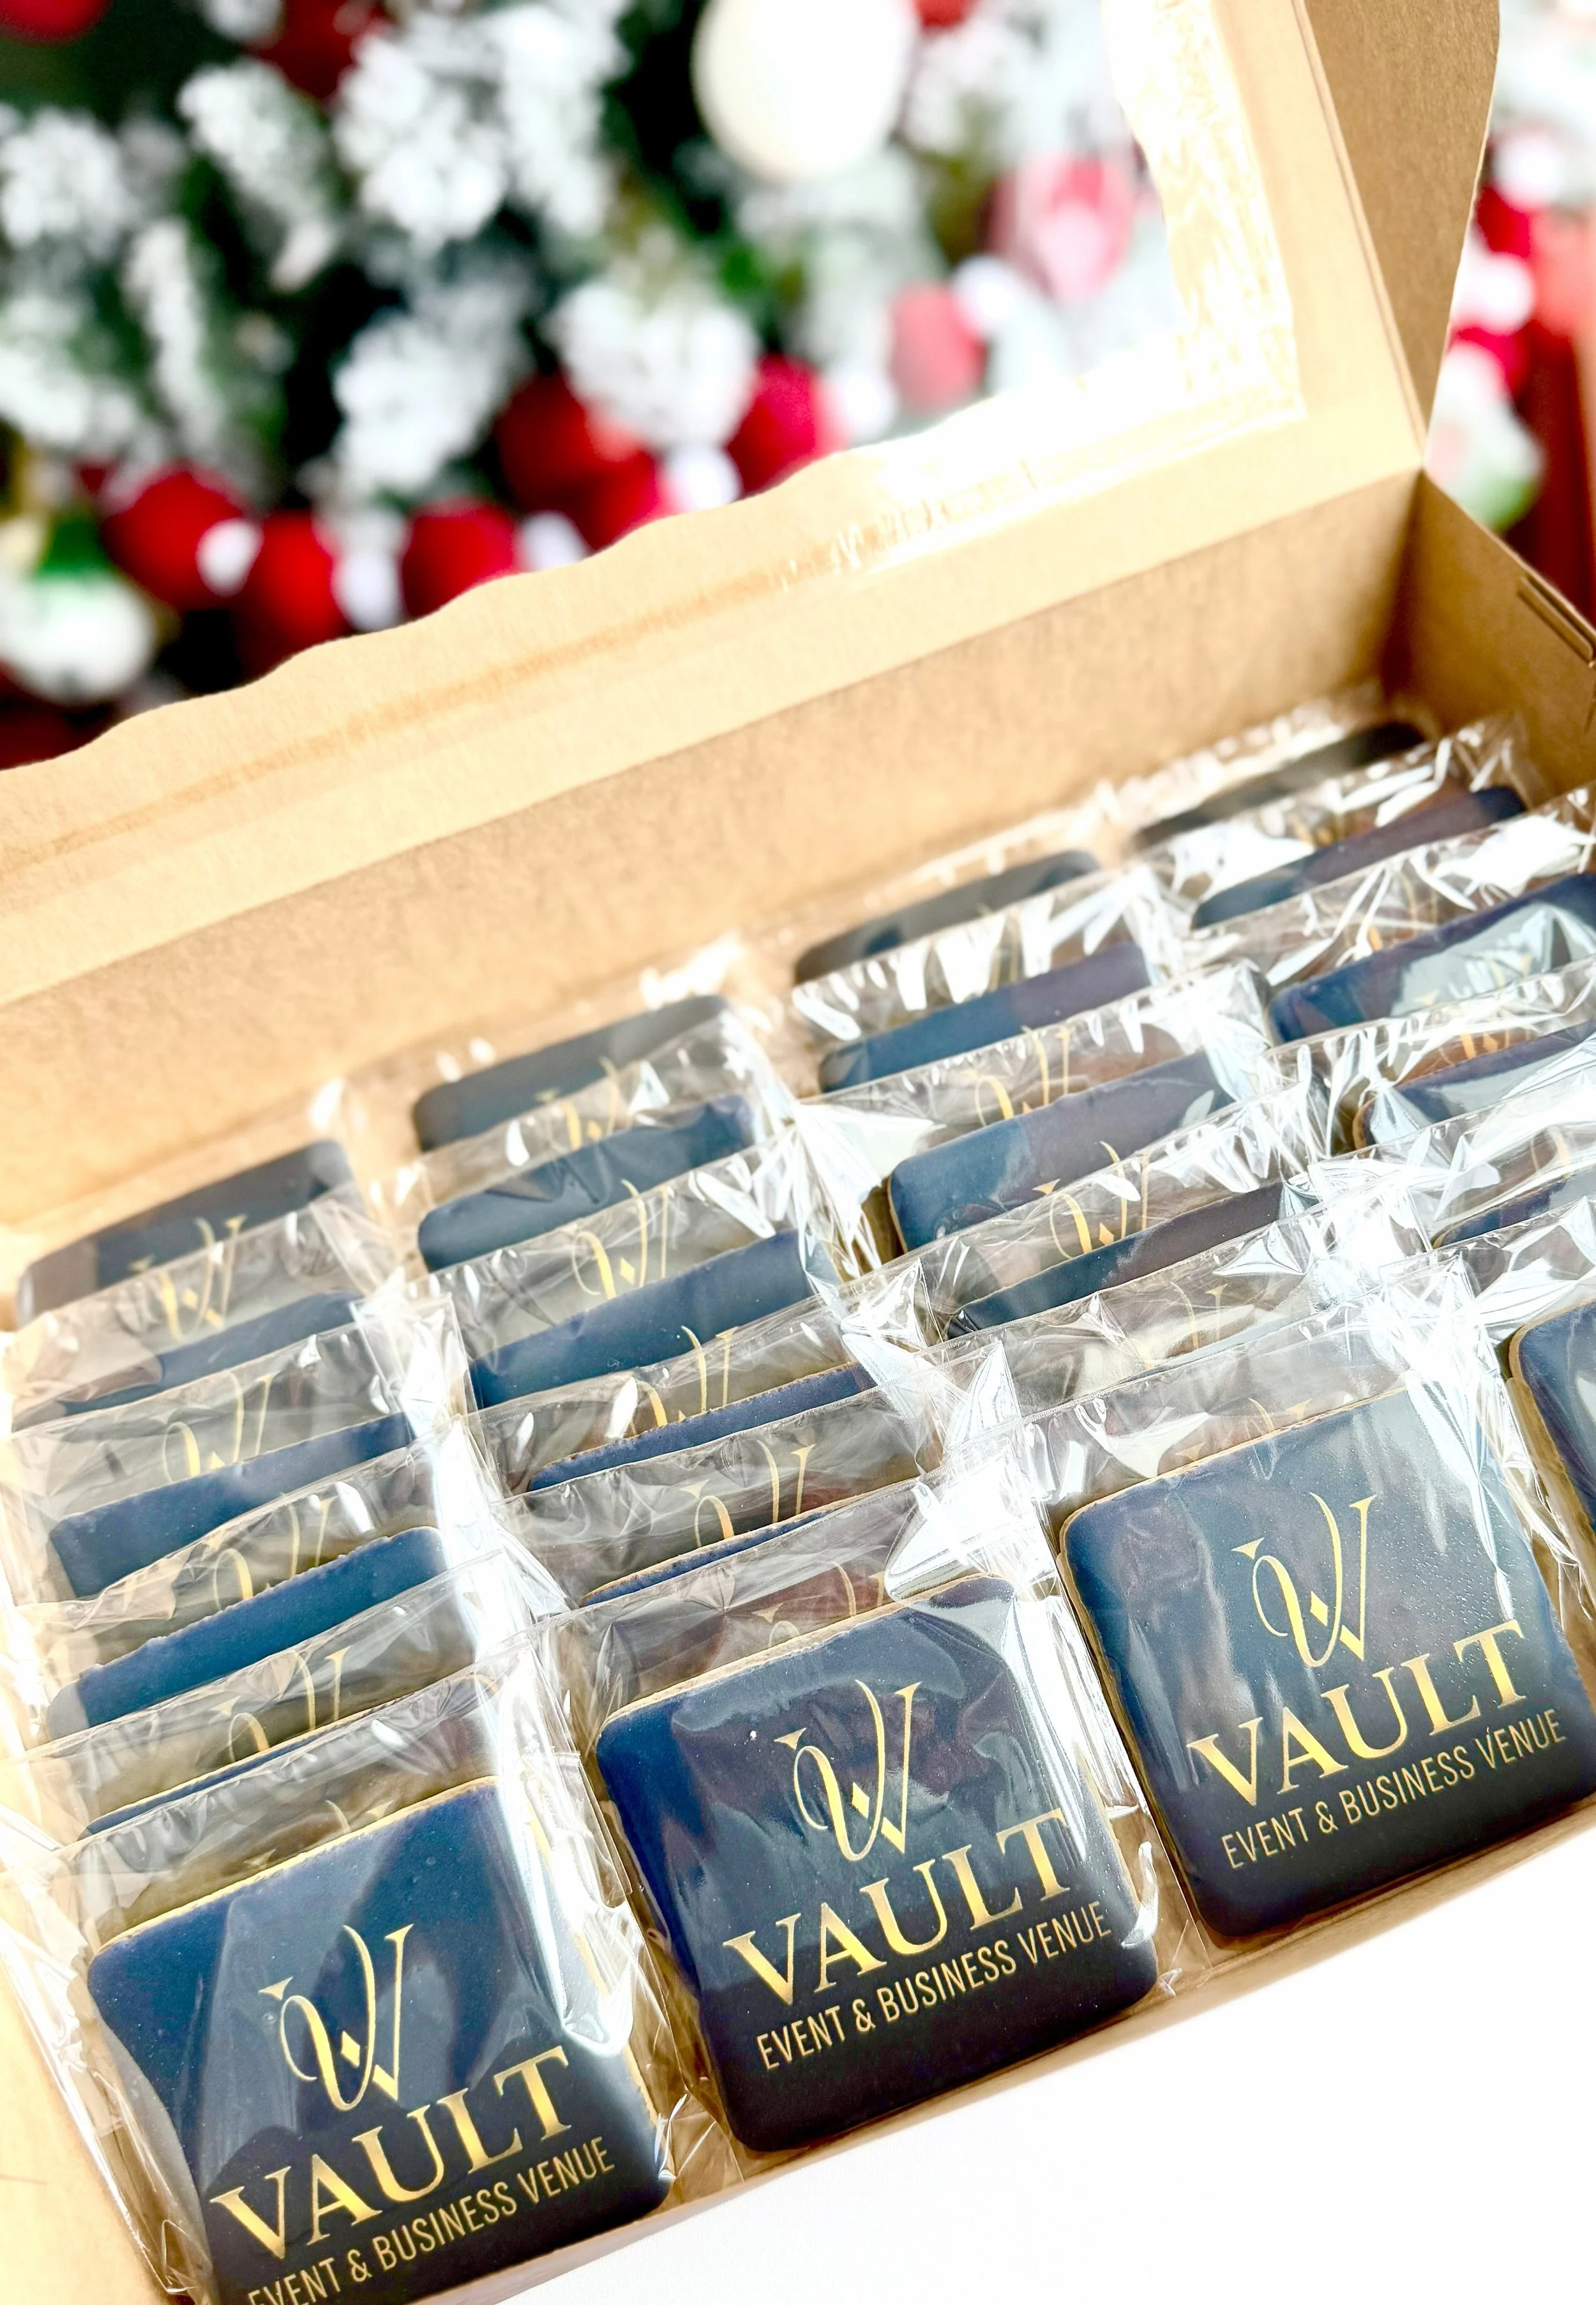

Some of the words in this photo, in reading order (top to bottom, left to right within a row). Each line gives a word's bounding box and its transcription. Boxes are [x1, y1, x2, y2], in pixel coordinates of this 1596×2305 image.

[1186, 1620, 1526, 1806] VAULT
[1221, 1807, 1309, 1870] EVENT
[1315, 1801, 1338, 1834] &
[1338, 1745, 1475, 1825] BUSINESS
[1475, 1709, 1567, 1770] VENUE
[723, 1808, 1071, 2007] VAULT
[757, 2005, 845, 2069] EVENT
[852, 1999, 876, 2032] &
[877, 1939, 1017, 2023] BUSINESS
[1017, 1901, 1112, 1965] VENUE
[209, 2045, 572, 2260] VAULT
[347, 2249, 373, 2282] &
[372, 2181, 518, 2271] BUSINESS
[517, 2136, 615, 2205] VENUE
